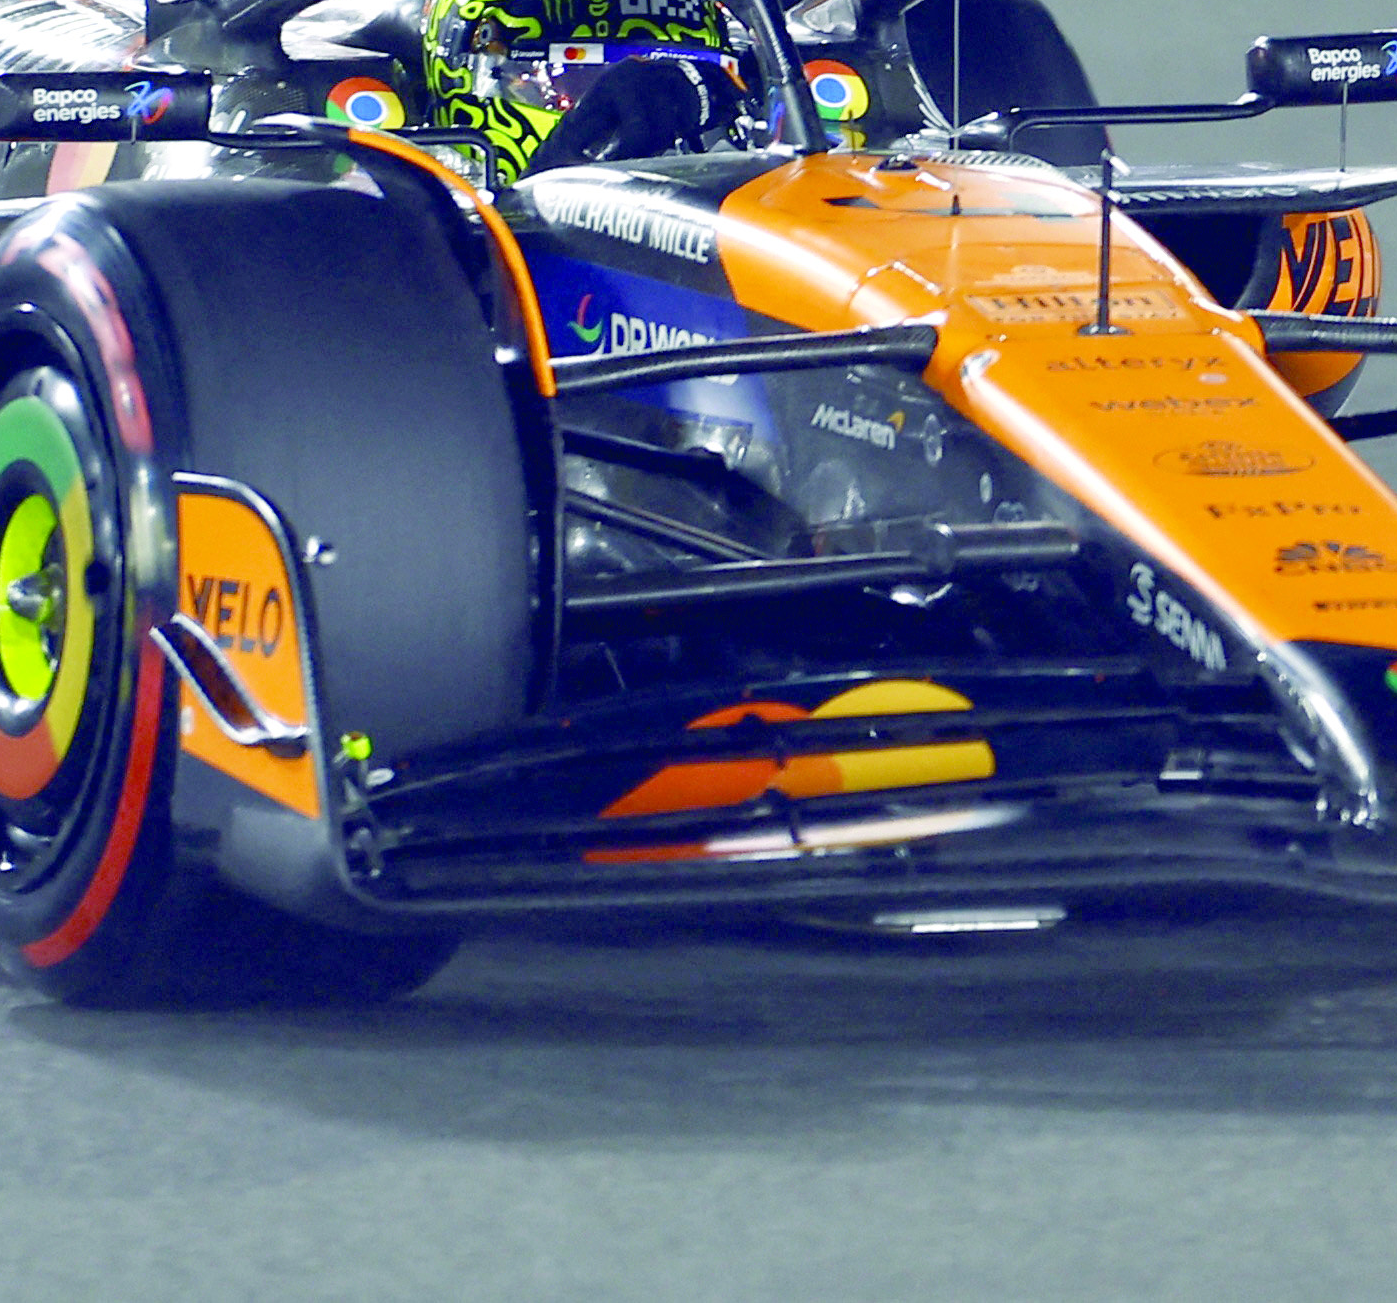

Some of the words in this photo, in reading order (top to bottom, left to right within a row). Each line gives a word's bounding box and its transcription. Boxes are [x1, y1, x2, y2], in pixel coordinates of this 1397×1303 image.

[1307, 48, 1361, 66] Bapco
[1311, 62, 1381, 84] energies
[32, 88, 98, 108] Bapco
[32, 104, 121, 126] energies
[648, 214, 716, 265] MILLE
[1280, 212, 1376, 317] VEL
[810, 403, 896, 450] McLaren
[186, 573, 284, 659] VELO
